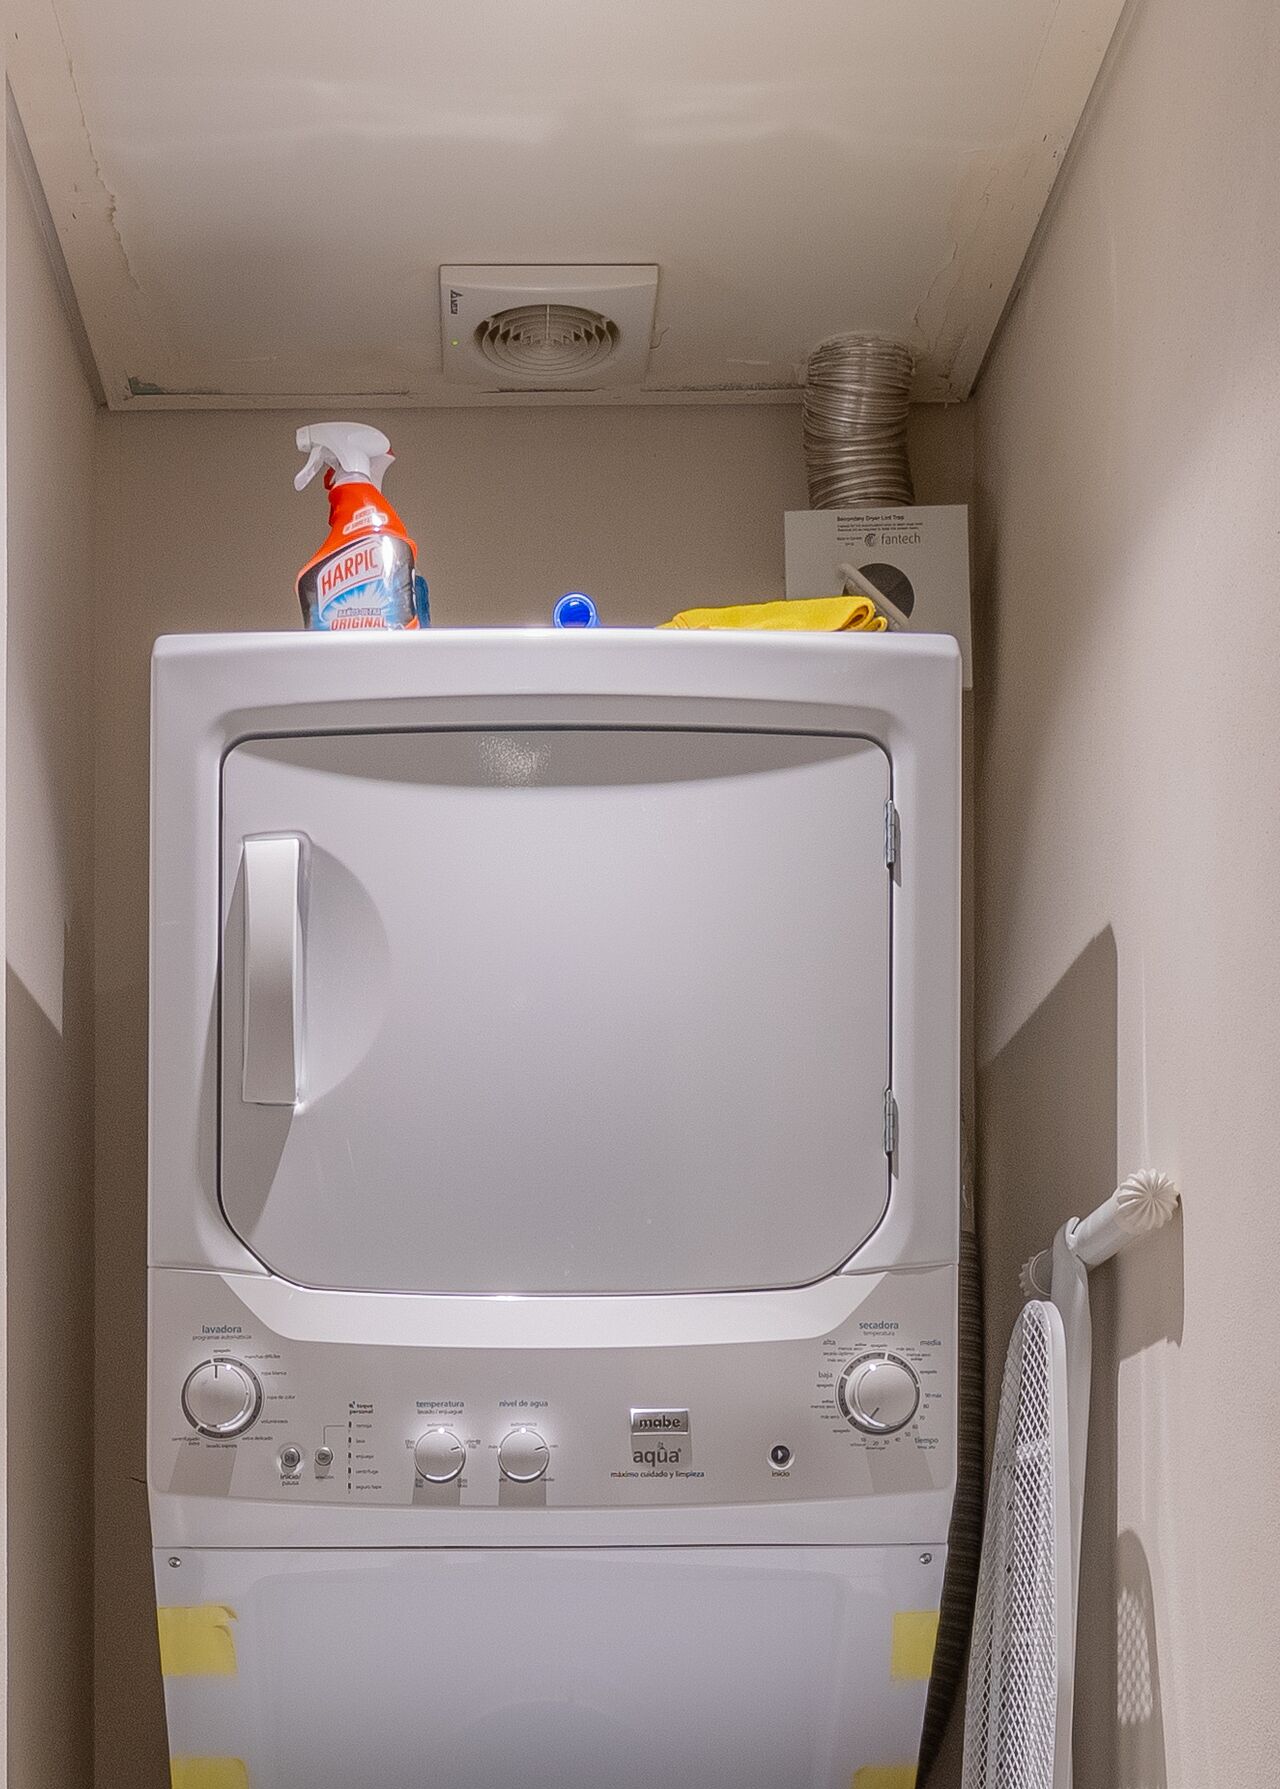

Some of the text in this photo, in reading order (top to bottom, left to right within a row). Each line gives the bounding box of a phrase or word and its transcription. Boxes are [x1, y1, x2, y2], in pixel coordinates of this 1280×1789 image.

[881, 532, 921, 545] fantech
[321, 547, 378, 596] HARPIC
[331, 616, 387, 630] ORIGINAL
[202, 1325, 242, 1334] lavadora
[859, 1321, 899, 1330] secadora
[416, 1401, 464, 1409] temperatura
[499, 1401, 548, 1409] nivel de agua
[639, 1415, 681, 1429] mabe
[640, 1470, 668, 1478] cuidado
[675, 1470, 705, 1479] limpieza
